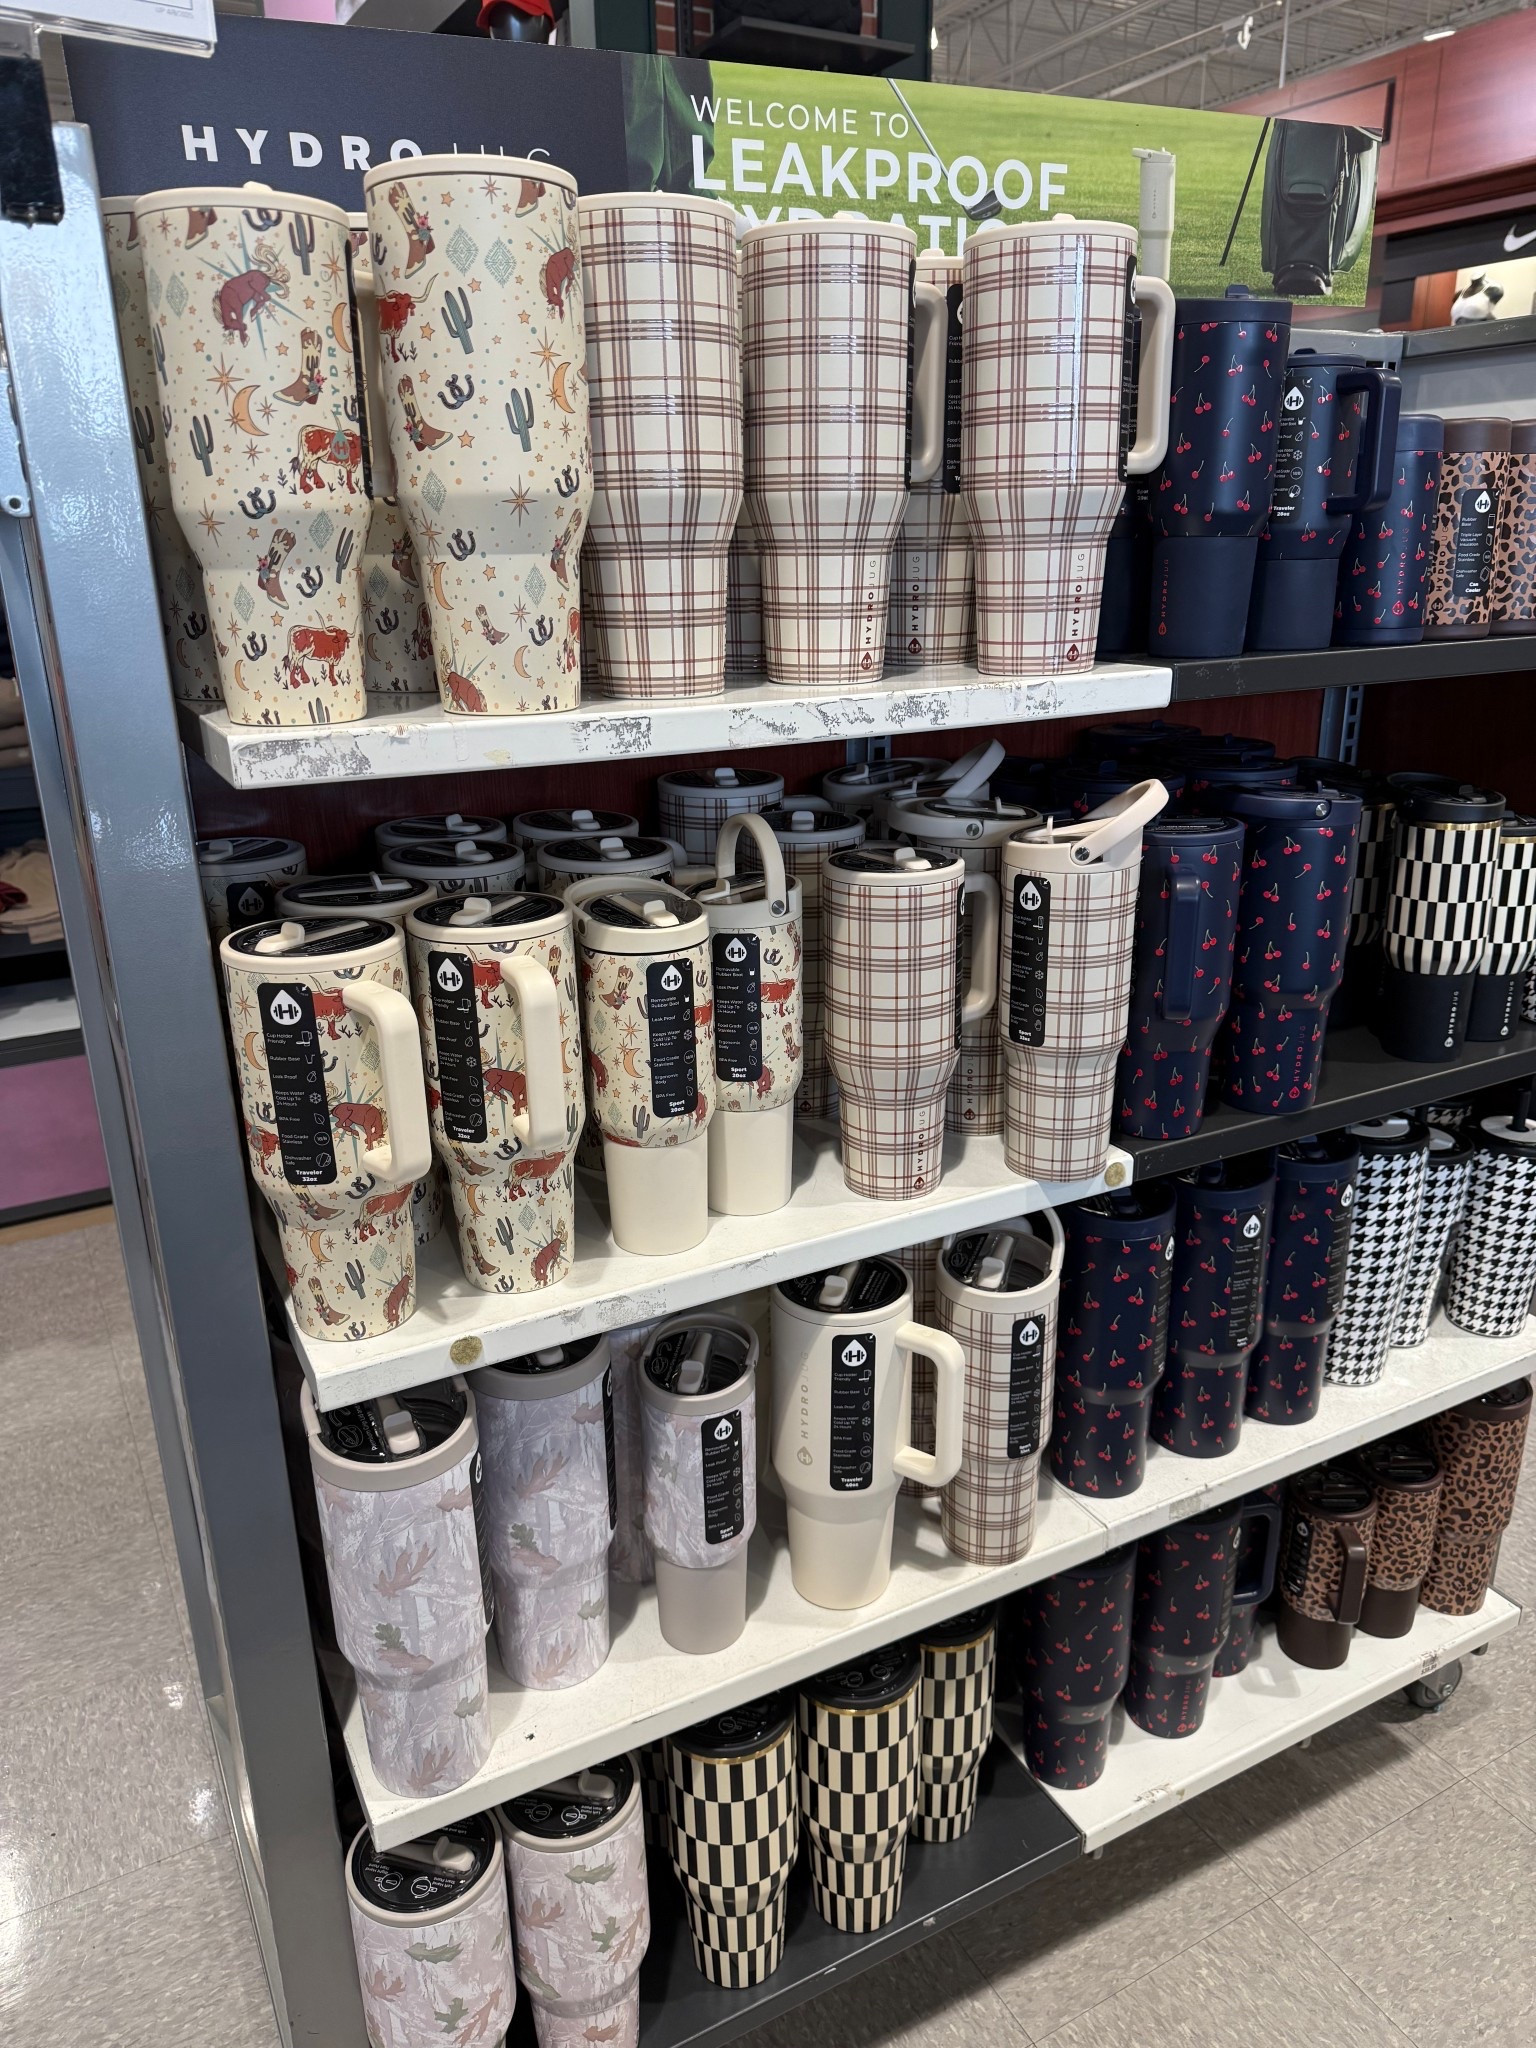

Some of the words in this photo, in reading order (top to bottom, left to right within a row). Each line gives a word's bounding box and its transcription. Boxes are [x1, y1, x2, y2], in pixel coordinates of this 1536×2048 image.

[691, 95, 857, 135] WELCOME
[870, 111, 909, 138] TO
[692, 134, 1067, 211] LEAKPROOF
[865, 560, 876, 644] HYDROJUG
[912, 556, 920, 631] HYDROJUG
[1072, 553, 1085, 637] HYDROJUG
[918, 1110, 926, 1172] HYDROJUG
